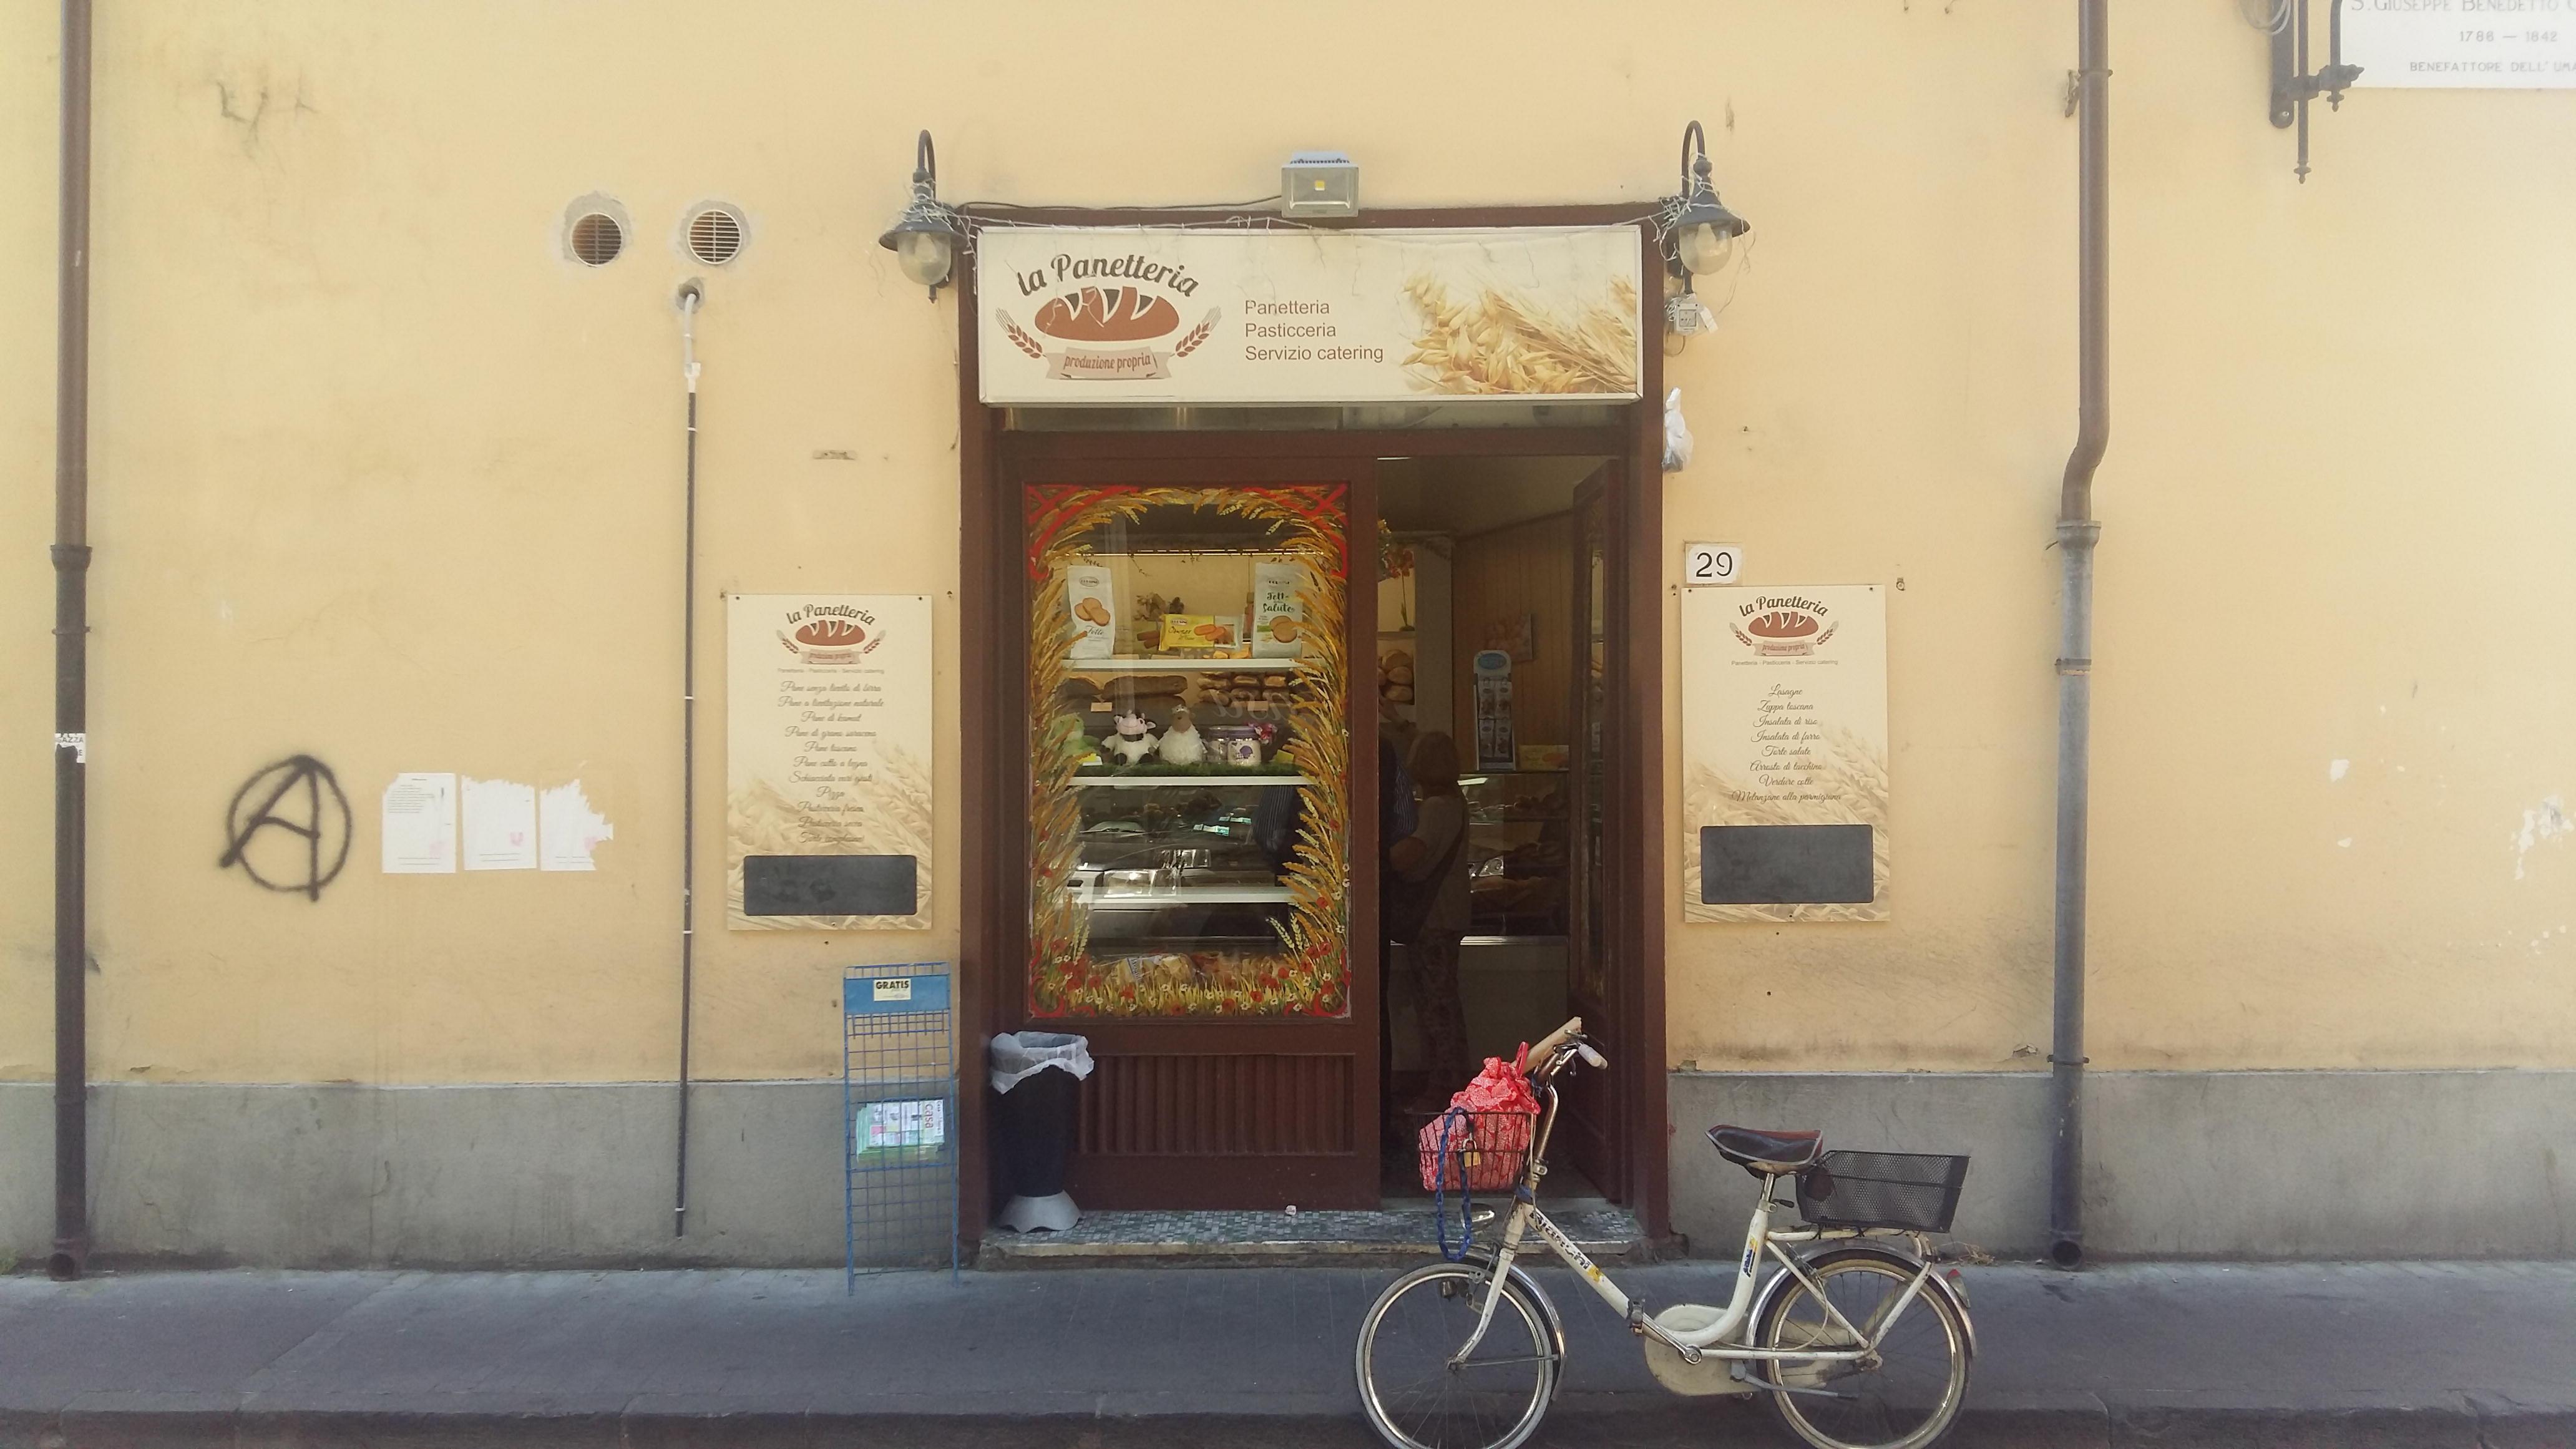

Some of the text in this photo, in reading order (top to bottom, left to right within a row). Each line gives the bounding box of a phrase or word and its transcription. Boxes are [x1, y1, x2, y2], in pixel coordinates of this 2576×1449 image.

[2526, 31, 2559, 42] 1842
[2410, 62, 2502, 72] BENEFATTORE
[1017, 253, 1200, 298] la Panetteria
[1244, 300, 1330, 315] Panetteria
[1244, 323, 1337, 338] Pasticceria
[1244, 345, 1383, 363] Servizio catering
[1063, 353, 1151, 371] produzione propria
[1695, 552, 1734, 578] 29
[1266, 592, 1289, 600] Fett
[1739, 595, 1828, 617] la Panetteria
[786, 603, 876, 625] la Panetteria
[1768, 683, 1803, 699] Lasagne
[1757, 700, 1814, 714] Zuppa toscana
[1752, 714, 1817, 728] Insalata di riso
[1750, 729, 1821, 744] Insalata di farro
[1761, 745, 1812, 757] Torte salate
[1749, 760, 1822, 771] Arrosto di tacchino
[1759, 774, 1795, 787] Verdure
[1731, 789, 1842, 806] Melanzane alla parmigiana
[876, 980, 909, 990] GRATIS
